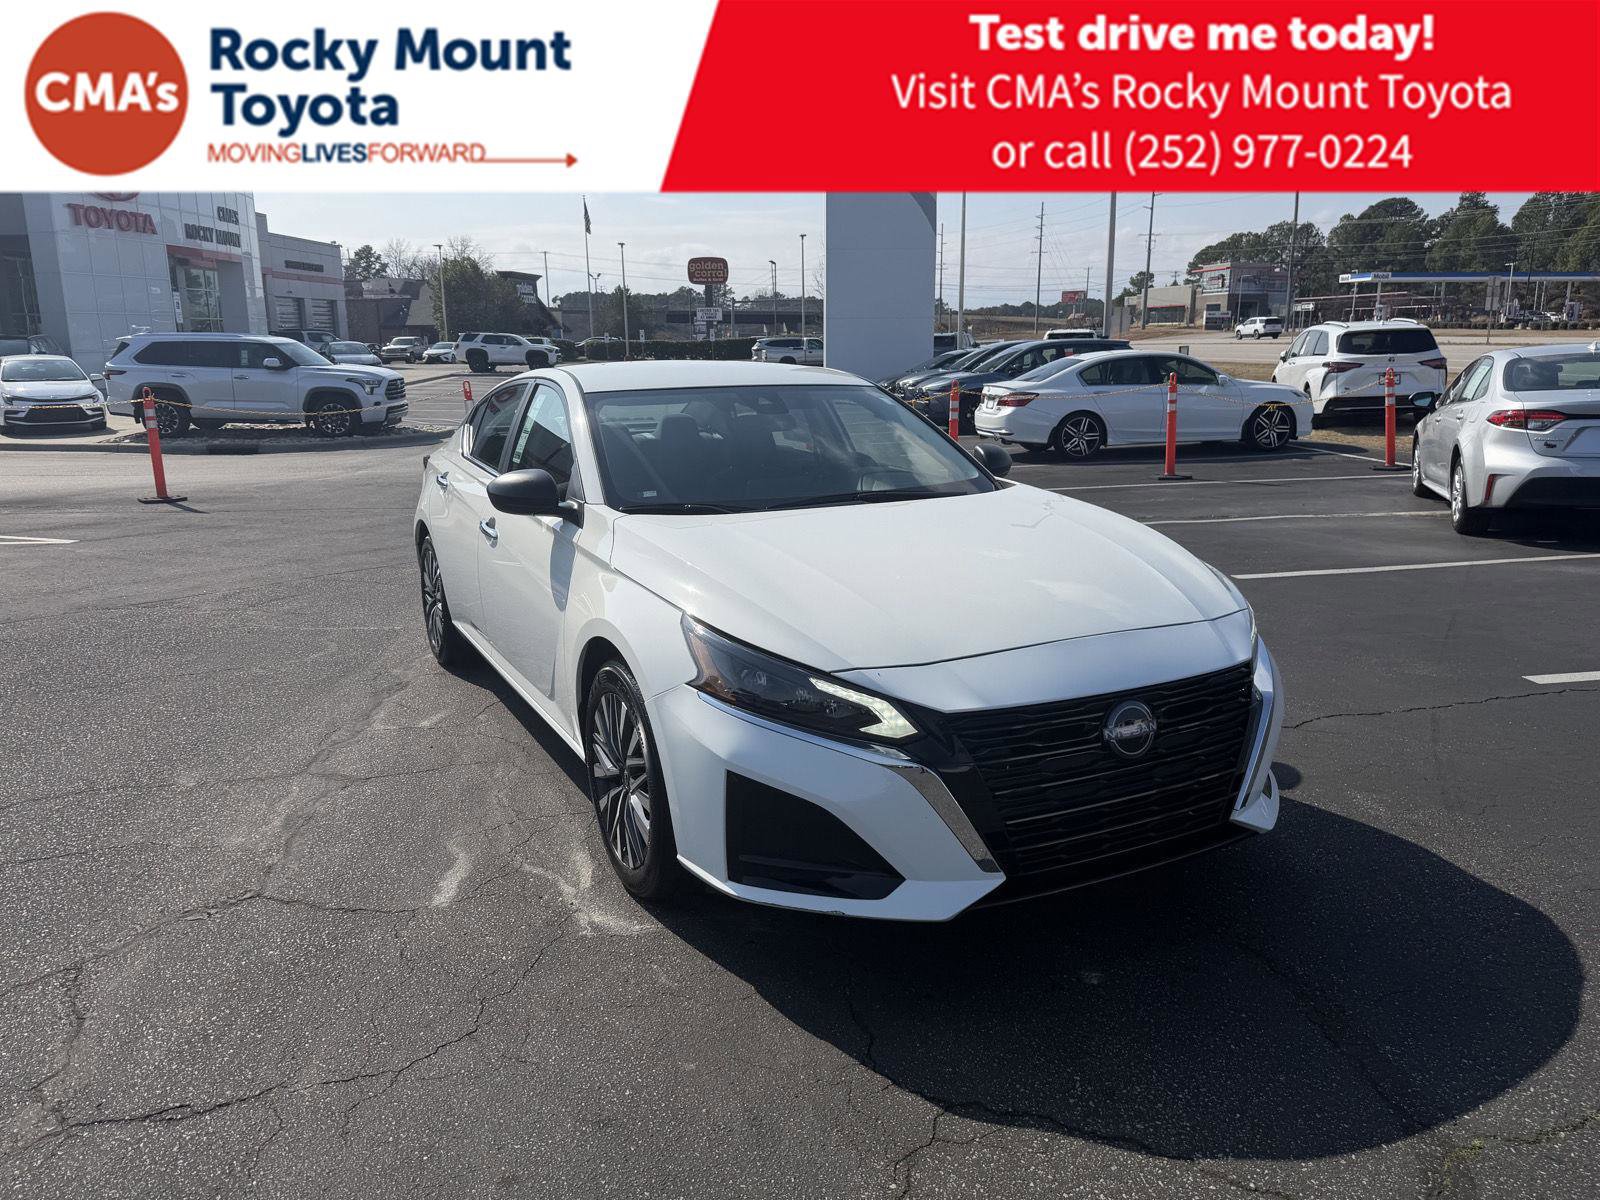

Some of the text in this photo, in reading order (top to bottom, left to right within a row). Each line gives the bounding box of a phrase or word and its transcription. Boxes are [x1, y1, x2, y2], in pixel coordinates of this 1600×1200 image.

[66, 203, 158, 235] TOYOTA
[184, 223, 241, 248] ROCKY MOUNT
[689, 261, 724, 272] golden
[694, 269, 727, 277] corral
